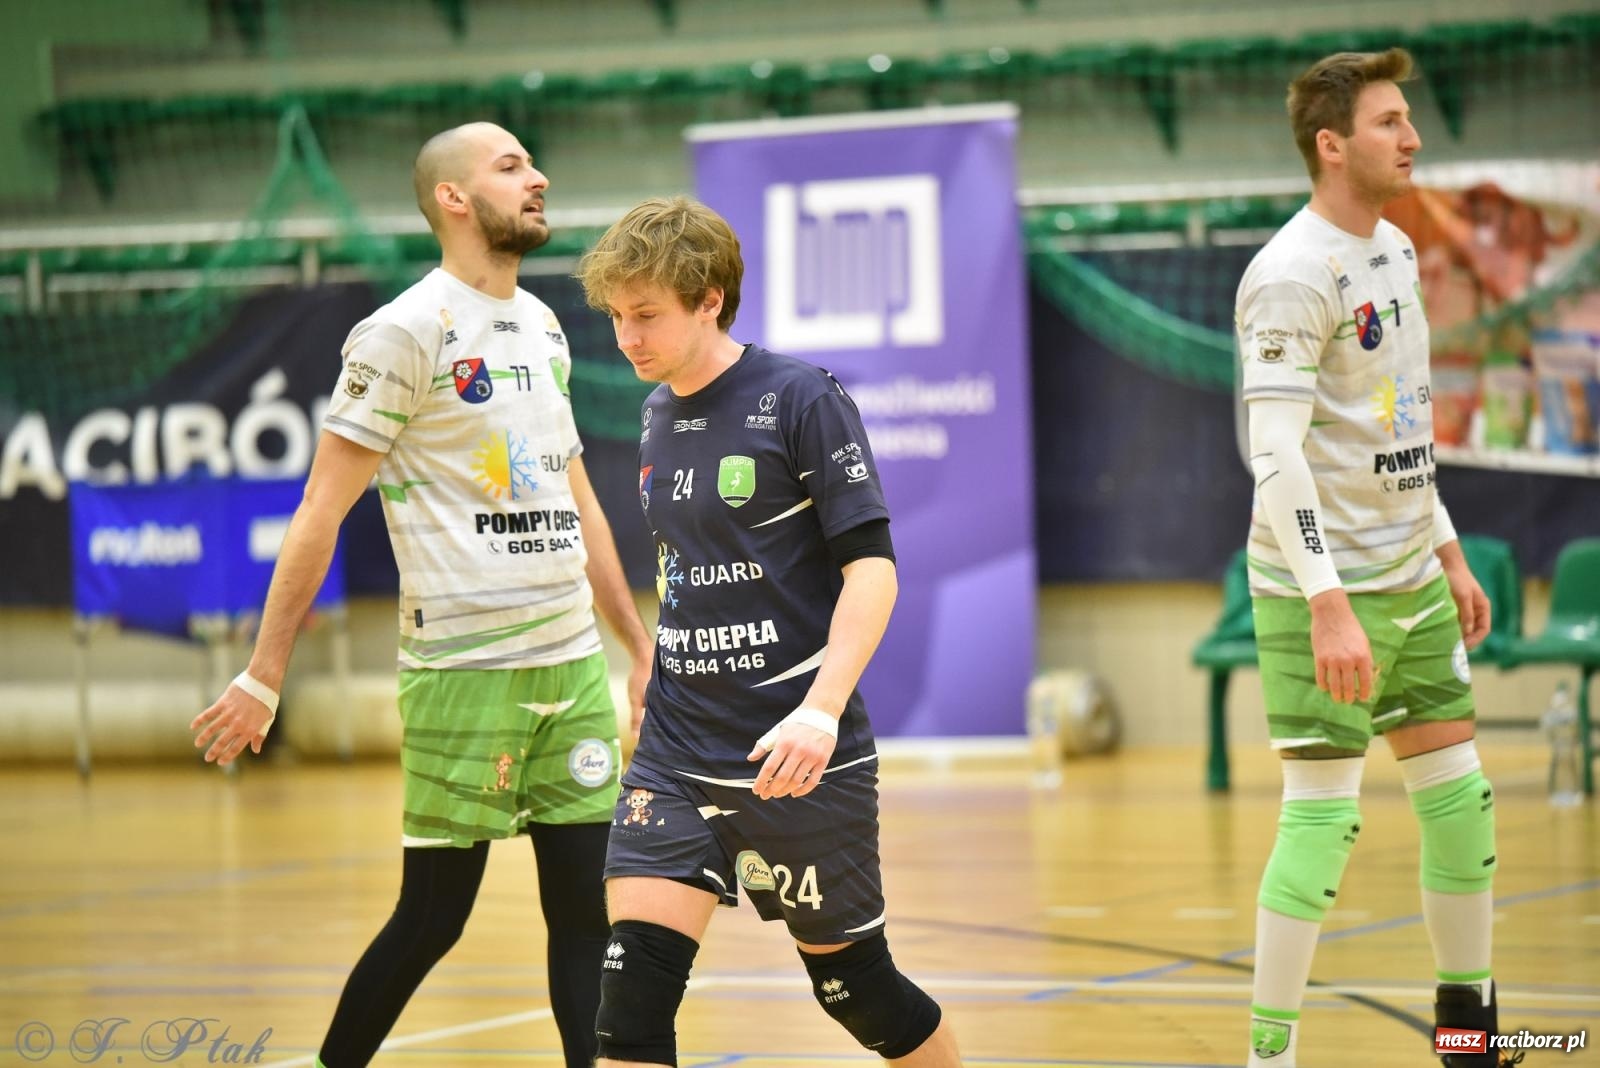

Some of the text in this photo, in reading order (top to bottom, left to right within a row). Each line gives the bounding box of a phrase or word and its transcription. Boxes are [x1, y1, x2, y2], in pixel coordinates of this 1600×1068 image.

[358, 362, 383, 380] SPORT
[509, 365, 531, 392] 77
[746, 414, 777, 425] MK SPORT
[831, 447, 846, 461] MK
[1373, 443, 1428, 475] POMPY
[672, 467, 695, 501] 24
[1397, 474, 1425, 492] 605
[474, 509, 551, 535] POMPY
[508, 539, 545, 554] 605
[690, 560, 764, 587] GUARD
[695, 619, 780, 653] CIEPŁA
[685, 658, 720, 676] 944
[724, 652, 766, 673] 146
[772, 864, 824, 911] 24
